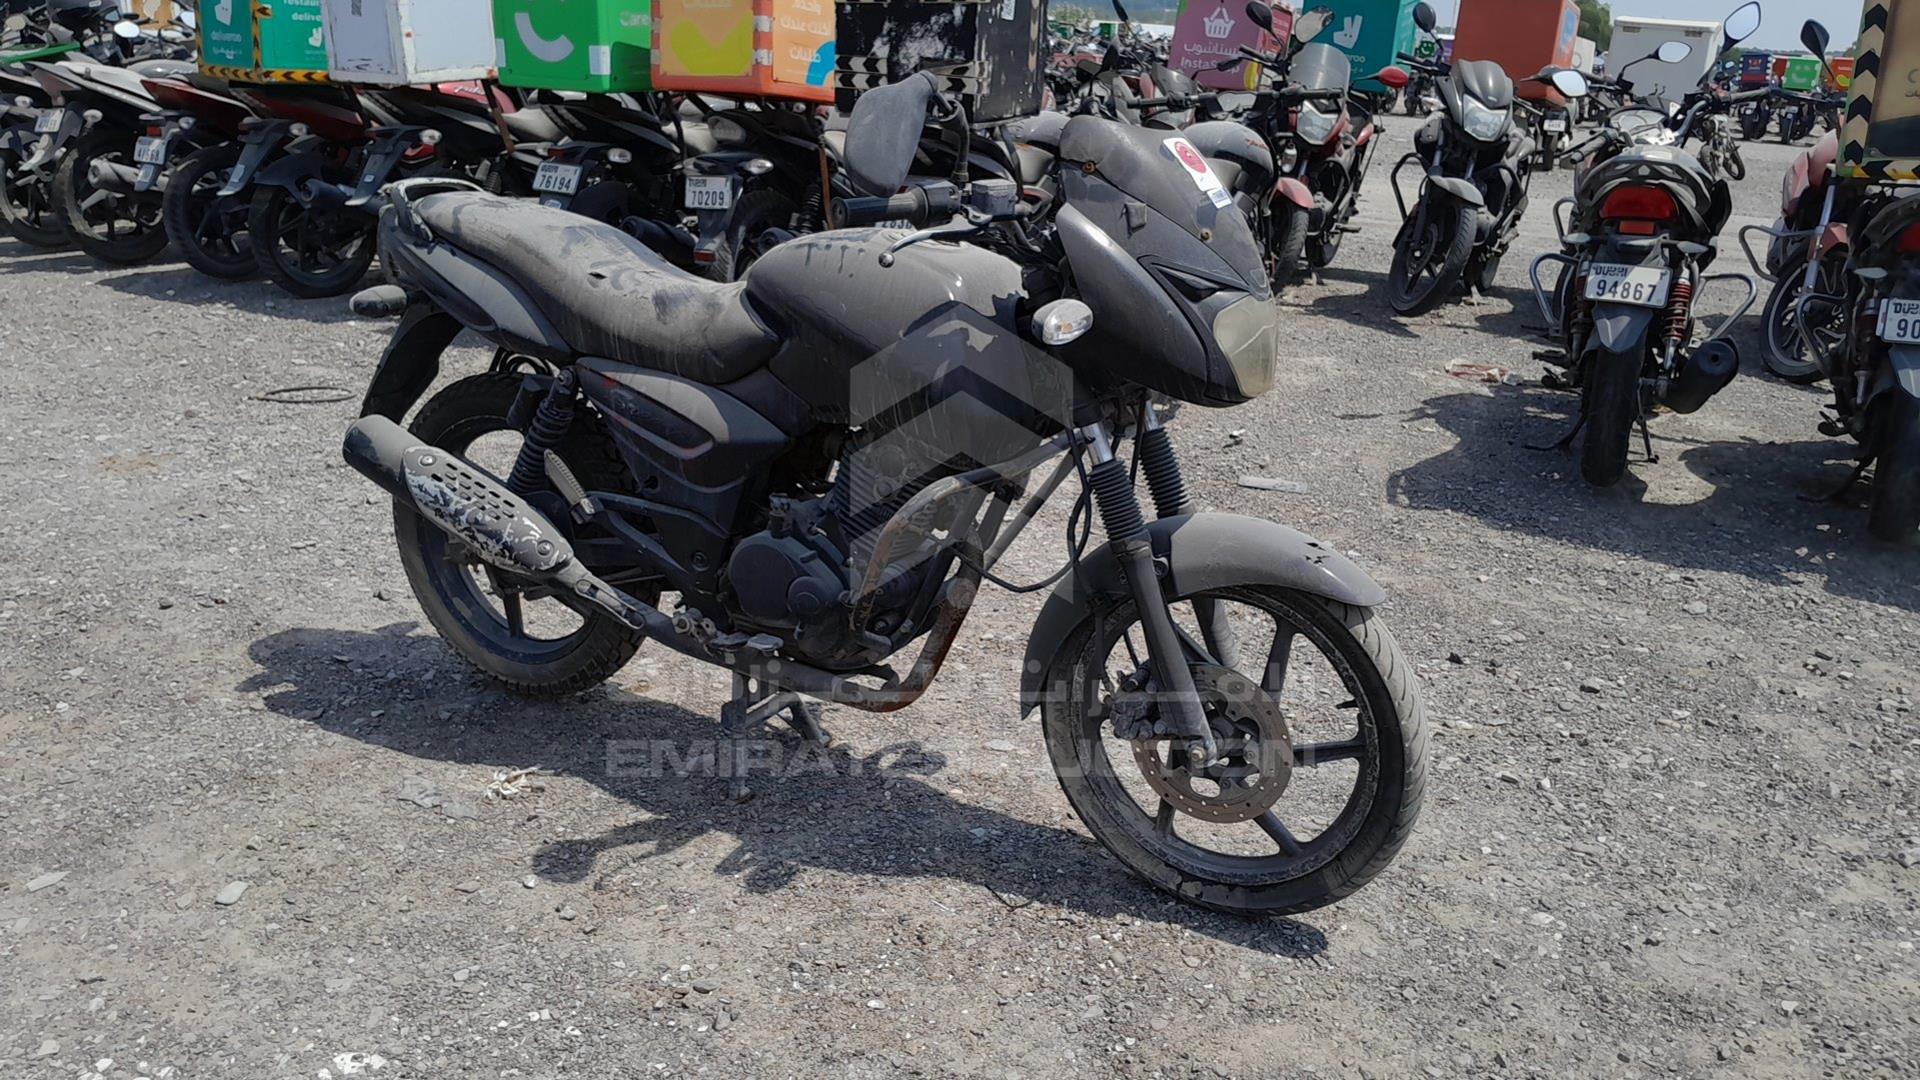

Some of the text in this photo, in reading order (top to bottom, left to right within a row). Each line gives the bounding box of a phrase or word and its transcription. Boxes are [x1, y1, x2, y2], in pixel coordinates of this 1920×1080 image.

[539, 174, 572, 191] 76194
[692, 190, 725, 206] 70209
[1596, 279, 1657, 302] 94867
[1896, 318, 1920, 339] 90
